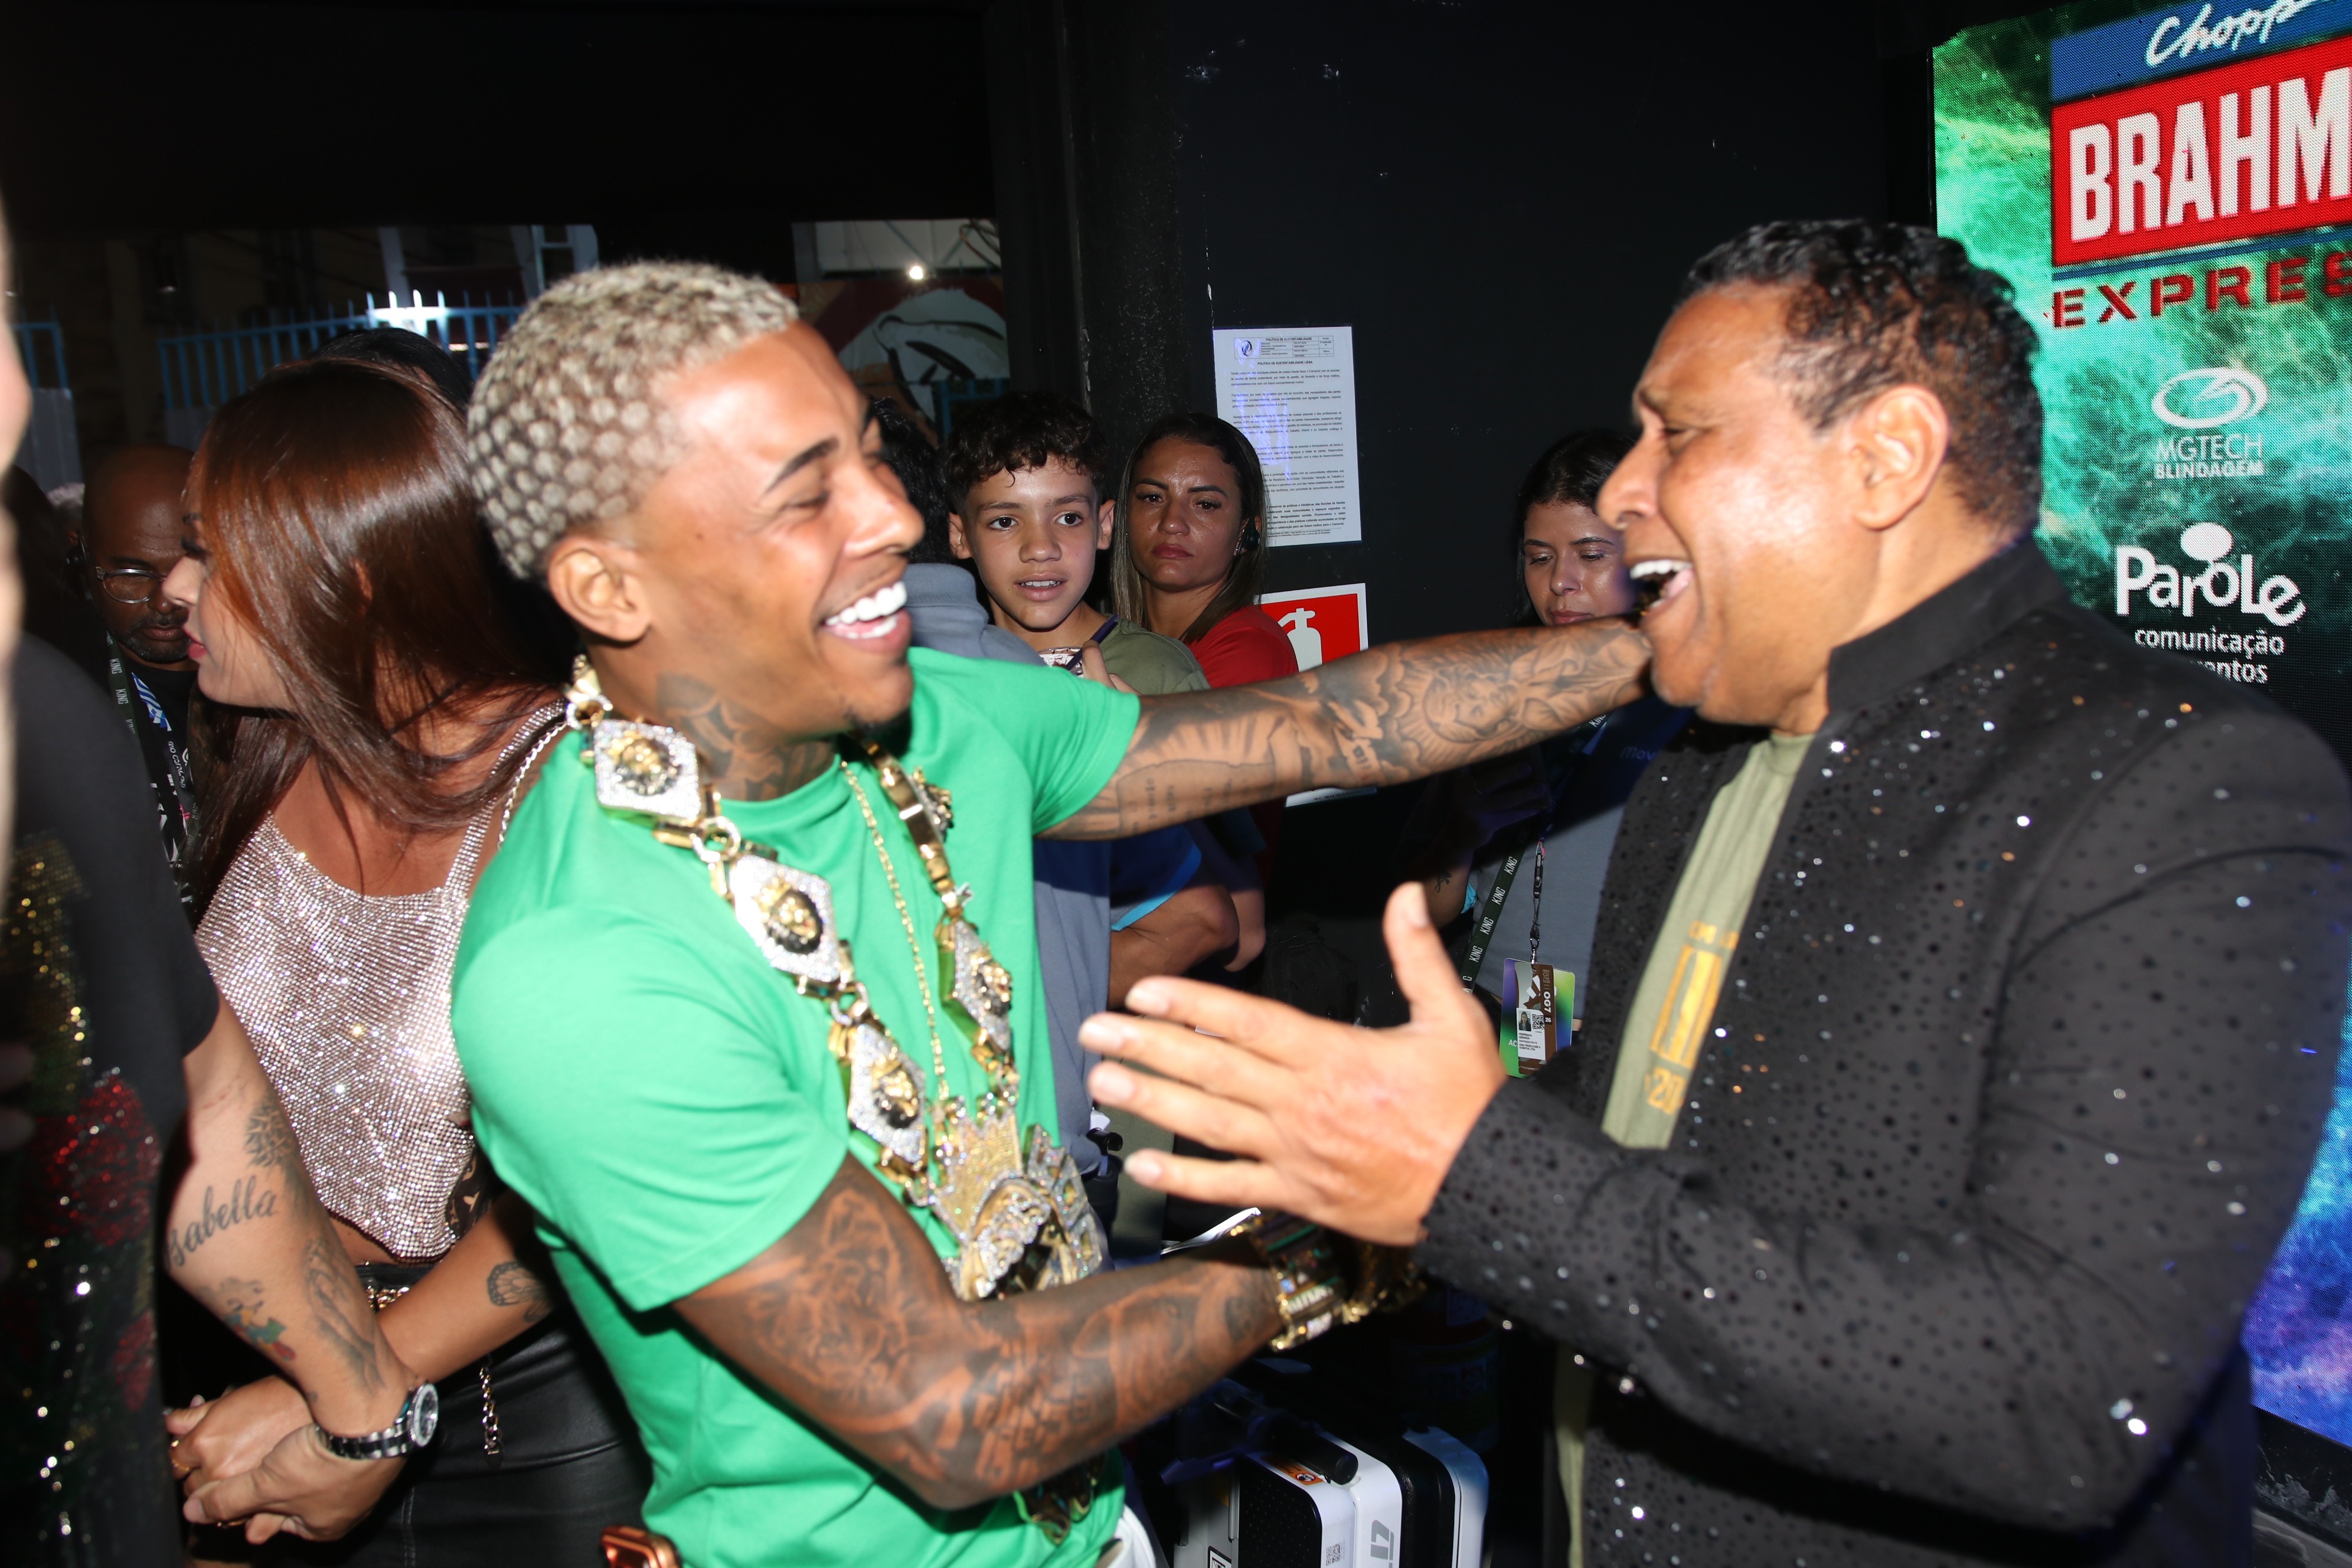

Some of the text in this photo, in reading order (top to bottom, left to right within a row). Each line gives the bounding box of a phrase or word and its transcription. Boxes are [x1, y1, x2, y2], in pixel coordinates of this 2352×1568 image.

[2145, 0, 2326, 68] Chopp
[2070, 66, 2352, 244] BRAHM
[2156, 433, 2263, 462] MGTECH
[2155, 460, 2265, 479] BLINDAGEM
[2134, 625, 2286, 659] comunicação
[110, 658, 122, 674] KING
[115, 688, 129, 705] KING
[1504, 856, 1518, 875] KING
[1491, 886, 1505, 905] KING
[1479, 916, 1494, 935] KING
[1469, 945, 1483, 962] KING
